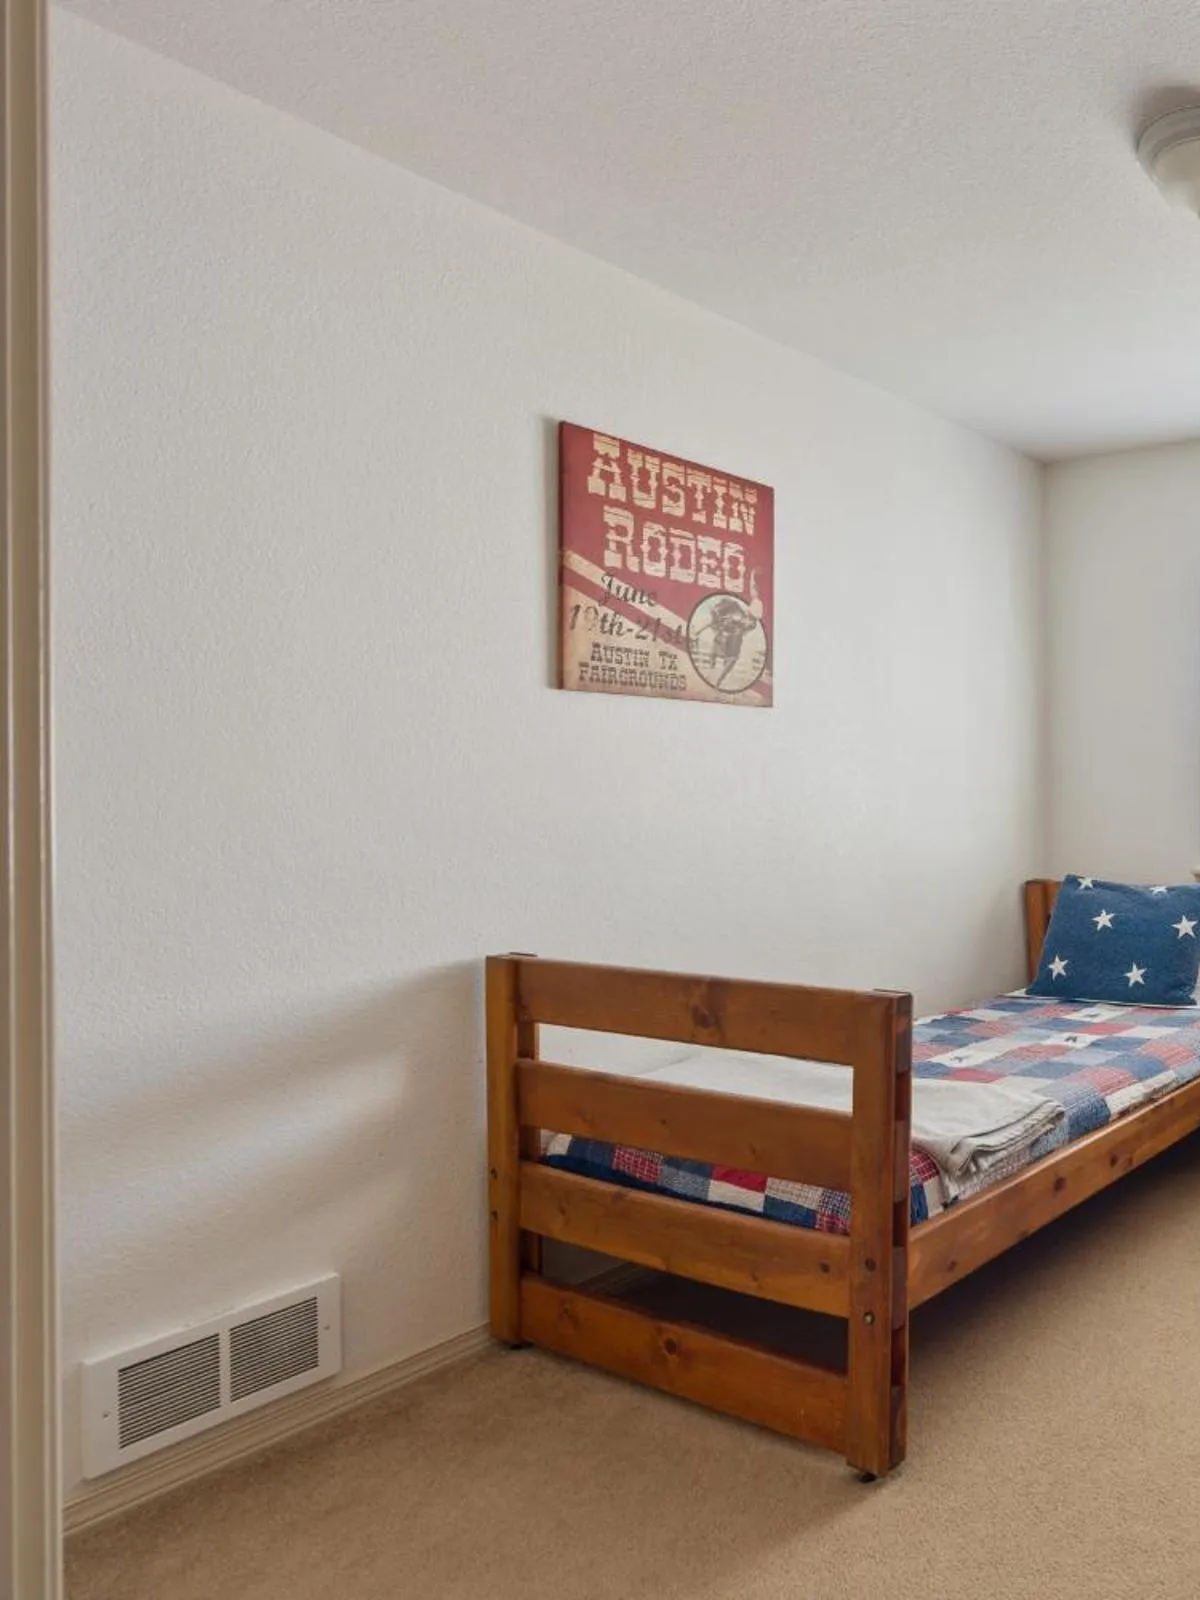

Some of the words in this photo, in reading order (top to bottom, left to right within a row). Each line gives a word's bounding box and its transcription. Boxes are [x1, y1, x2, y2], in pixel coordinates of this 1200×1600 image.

[588, 433, 757, 536] AUSTIN
[603, 505, 745, 592] RODEO
[578, 662, 687, 691] FAIRGROUNDS
[591, 642, 650, 668] AUSTIN
[659, 651, 679, 671] TX
